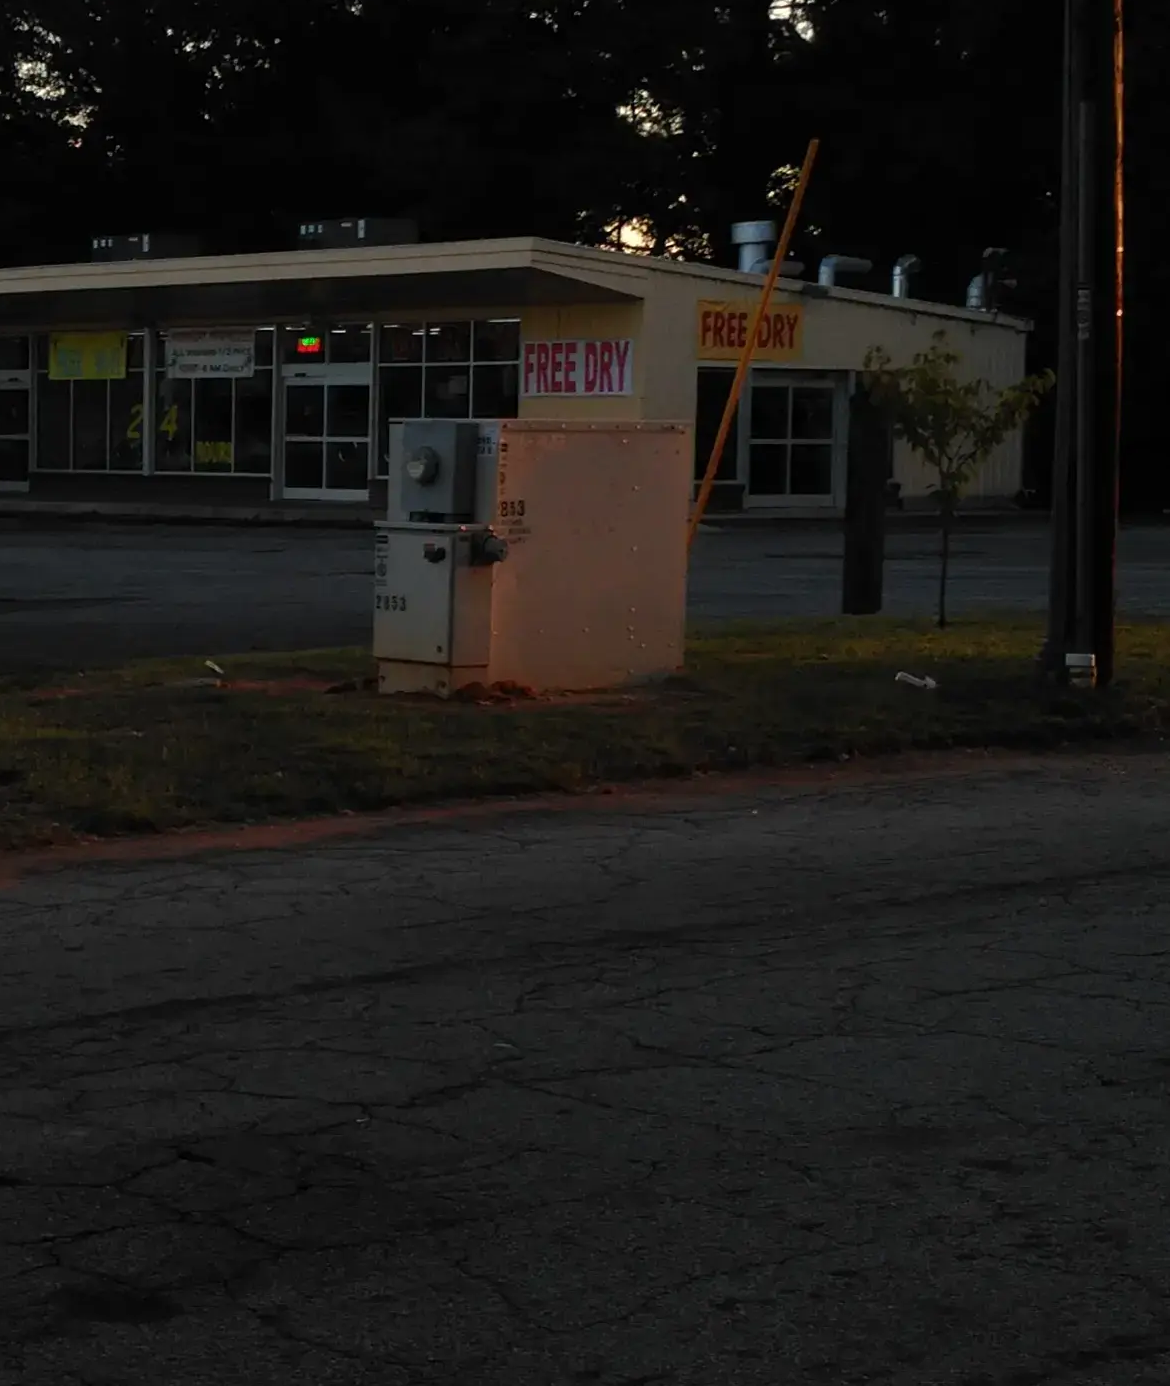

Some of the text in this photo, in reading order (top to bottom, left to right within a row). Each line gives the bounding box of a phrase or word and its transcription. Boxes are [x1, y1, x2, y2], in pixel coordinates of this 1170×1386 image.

[702, 311, 799, 350] FREE DRY
[524, 342, 577, 394] FREE
[584, 341, 630, 394] DRY
